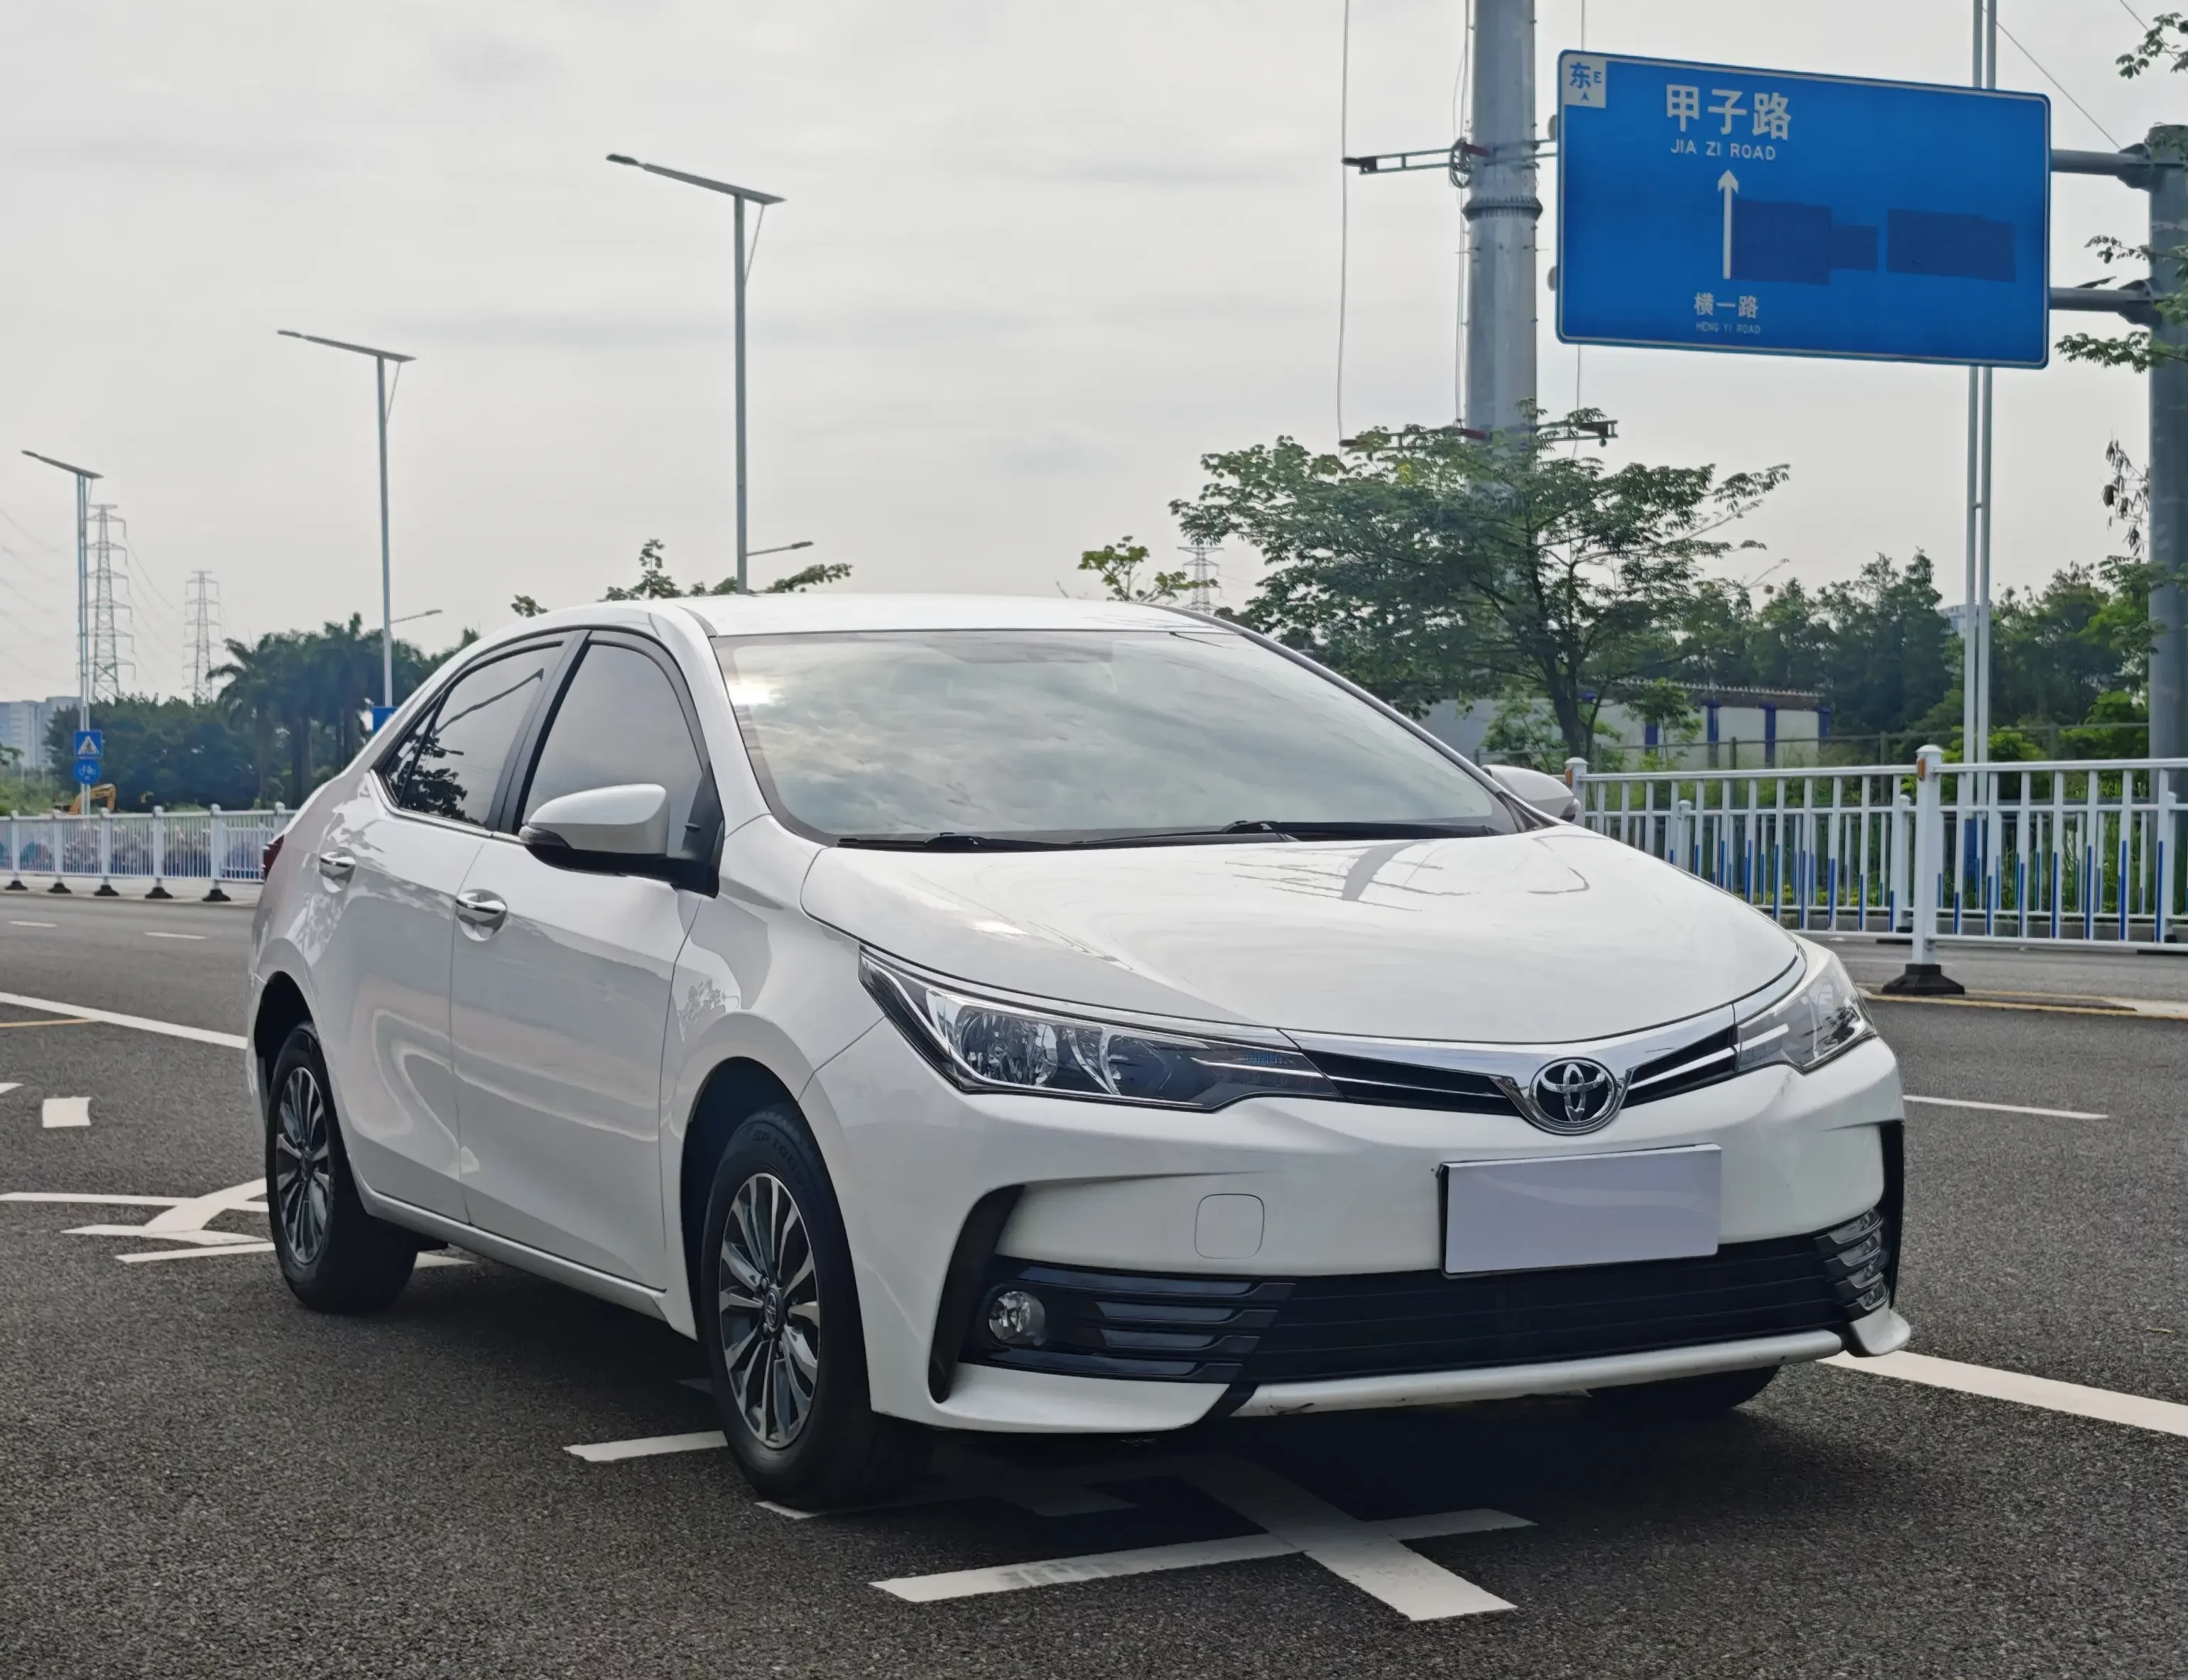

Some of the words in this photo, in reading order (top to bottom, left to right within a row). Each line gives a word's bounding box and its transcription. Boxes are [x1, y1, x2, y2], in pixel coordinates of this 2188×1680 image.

[1569, 61, 1591, 89] 东
[1593, 70, 1602, 84] E
[1666, 84, 1792, 141] 甲子路
[1670, 138, 1697, 155] JIA
[1705, 141, 1721, 156] ZI
[1730, 142, 1776, 160] ROAD
[1694, 292, 1758, 319] 横一路
[1736, 324, 1761, 334] ROAD
